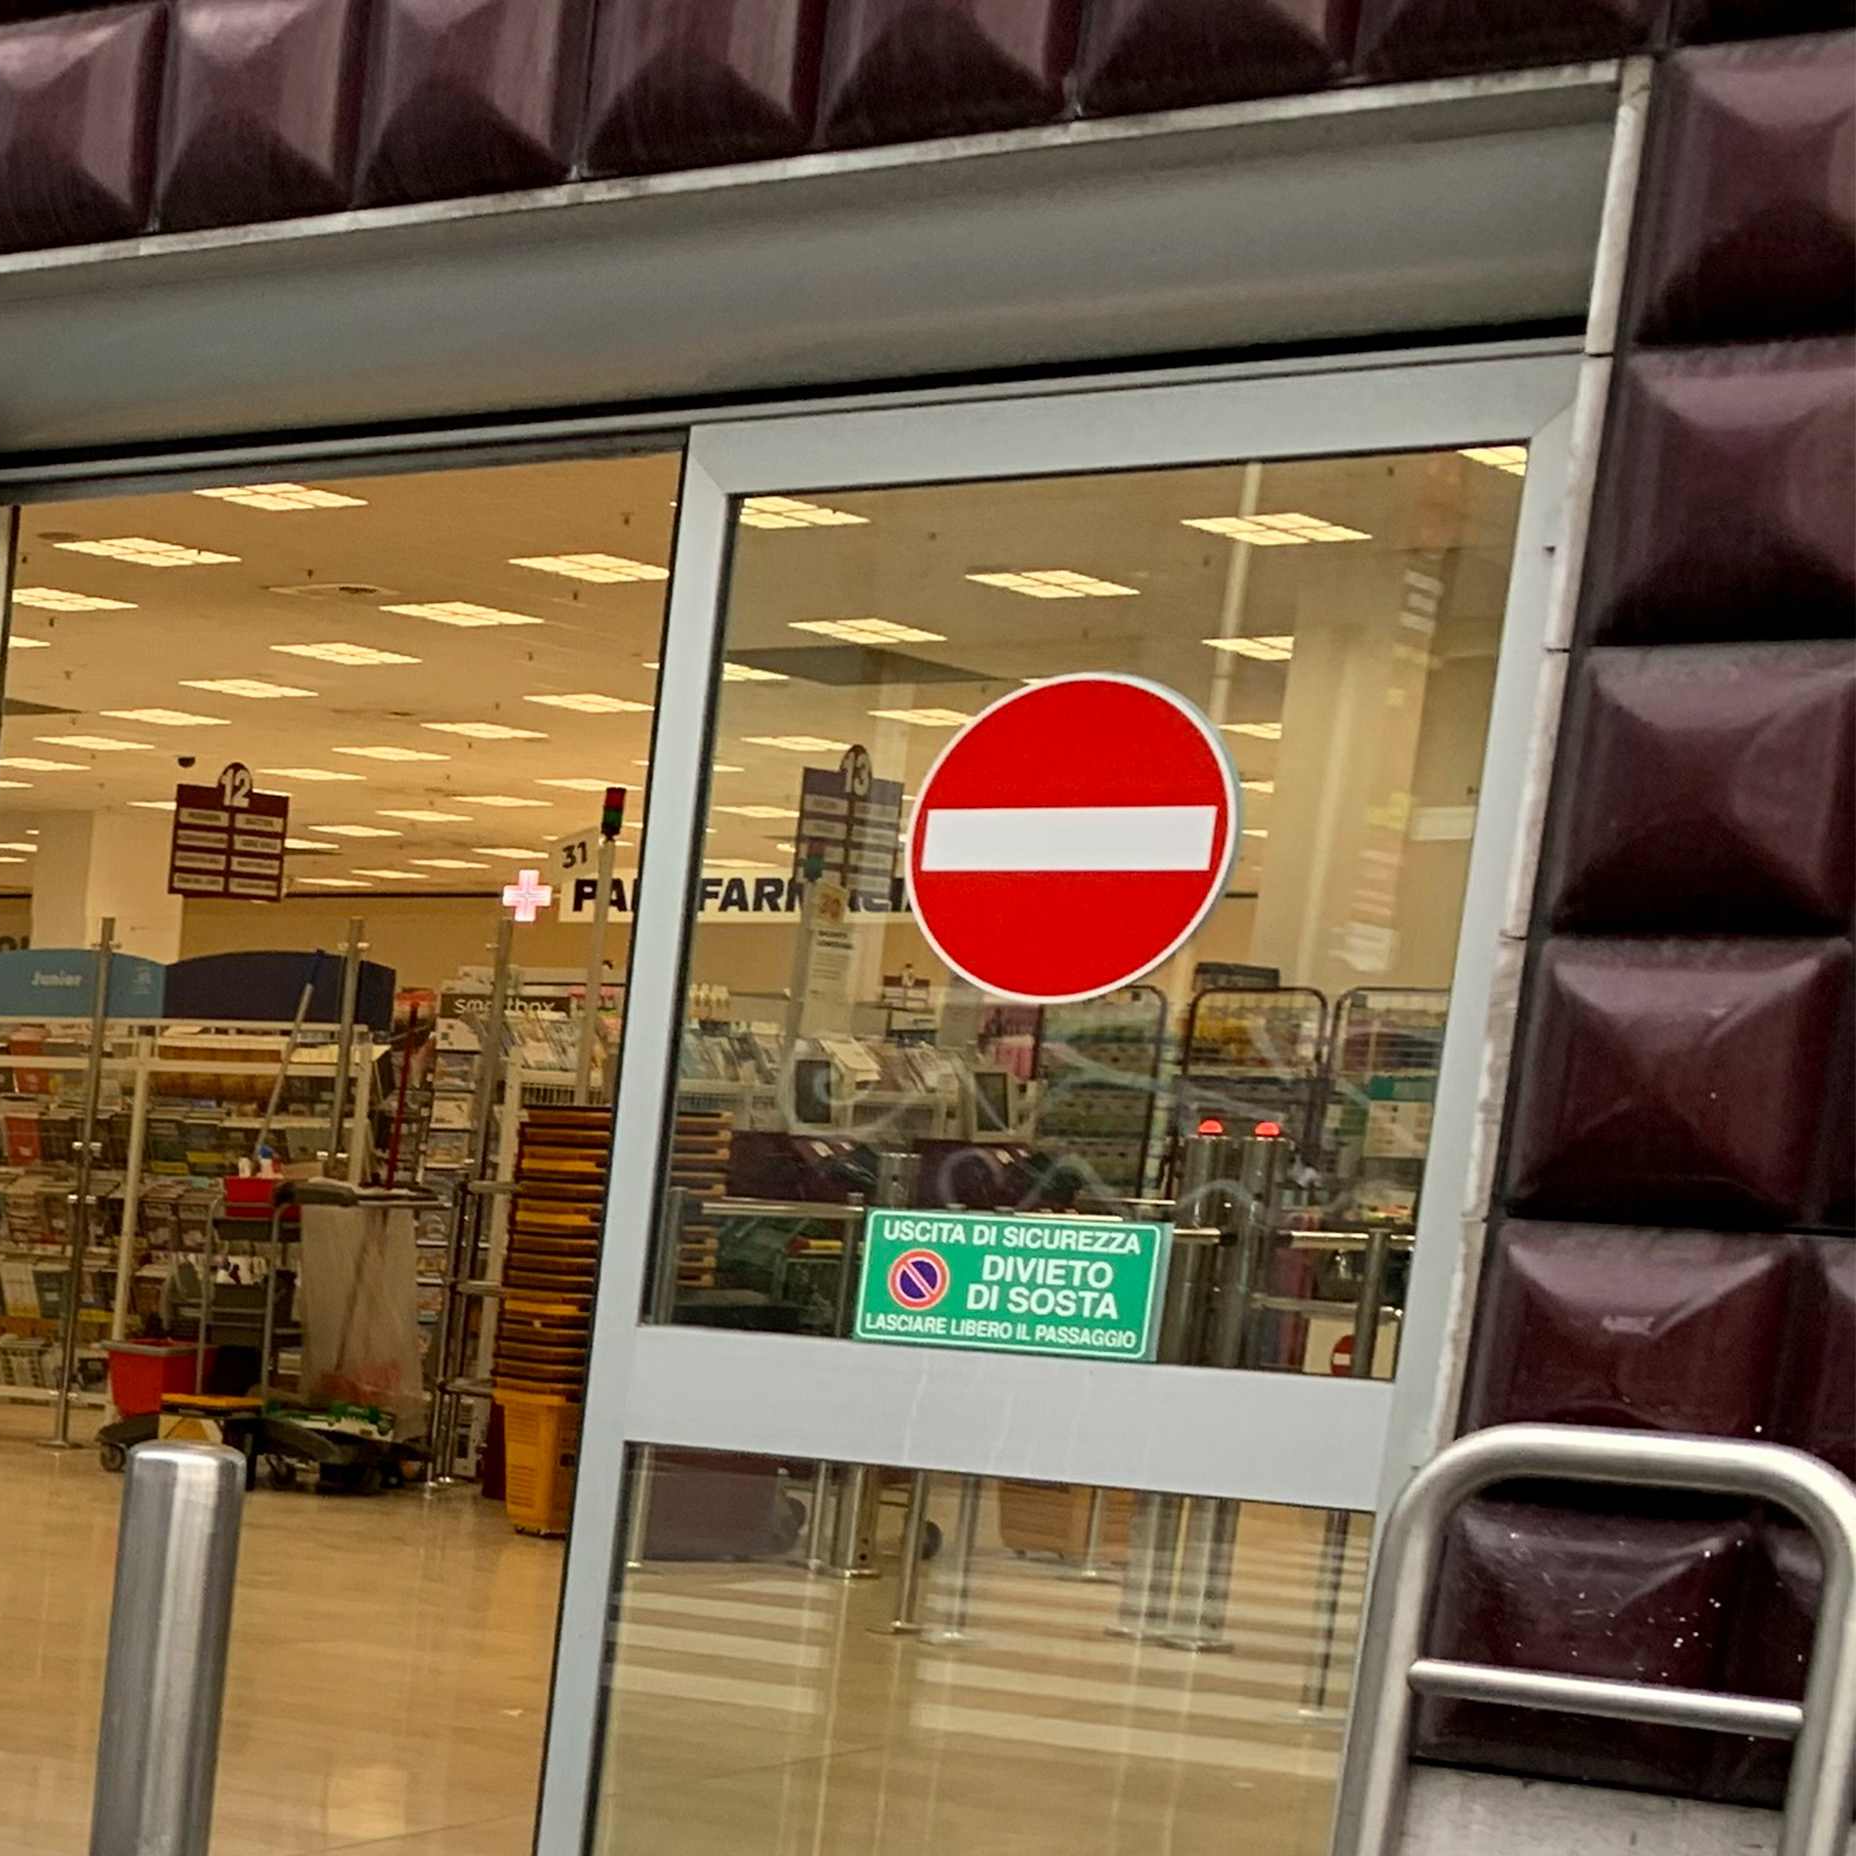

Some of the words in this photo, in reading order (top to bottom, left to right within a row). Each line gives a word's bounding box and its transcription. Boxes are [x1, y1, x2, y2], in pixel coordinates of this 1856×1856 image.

[221, 768, 251, 808] 12
[561, 841, 588, 869] 31
[31, 969, 83, 988] Junior
[453, 997, 555, 1018] smatbox
[883, 1219, 966, 1244] USCITA
[973, 1224, 997, 1246] DI
[1003, 1226, 1141, 1255] SICUREZZA
[982, 1254, 1114, 1289] DIVIETO
[966, 1284, 999, 1311] DI
[1007, 1287, 1119, 1320] SOSTA
[865, 1313, 947, 1335] LASCIARE
[950, 1318, 1013, 1339] LIBERO
[1015, 1322, 1030, 1341] IL
[1035, 1324, 1137, 1349] PASSAGGIO
